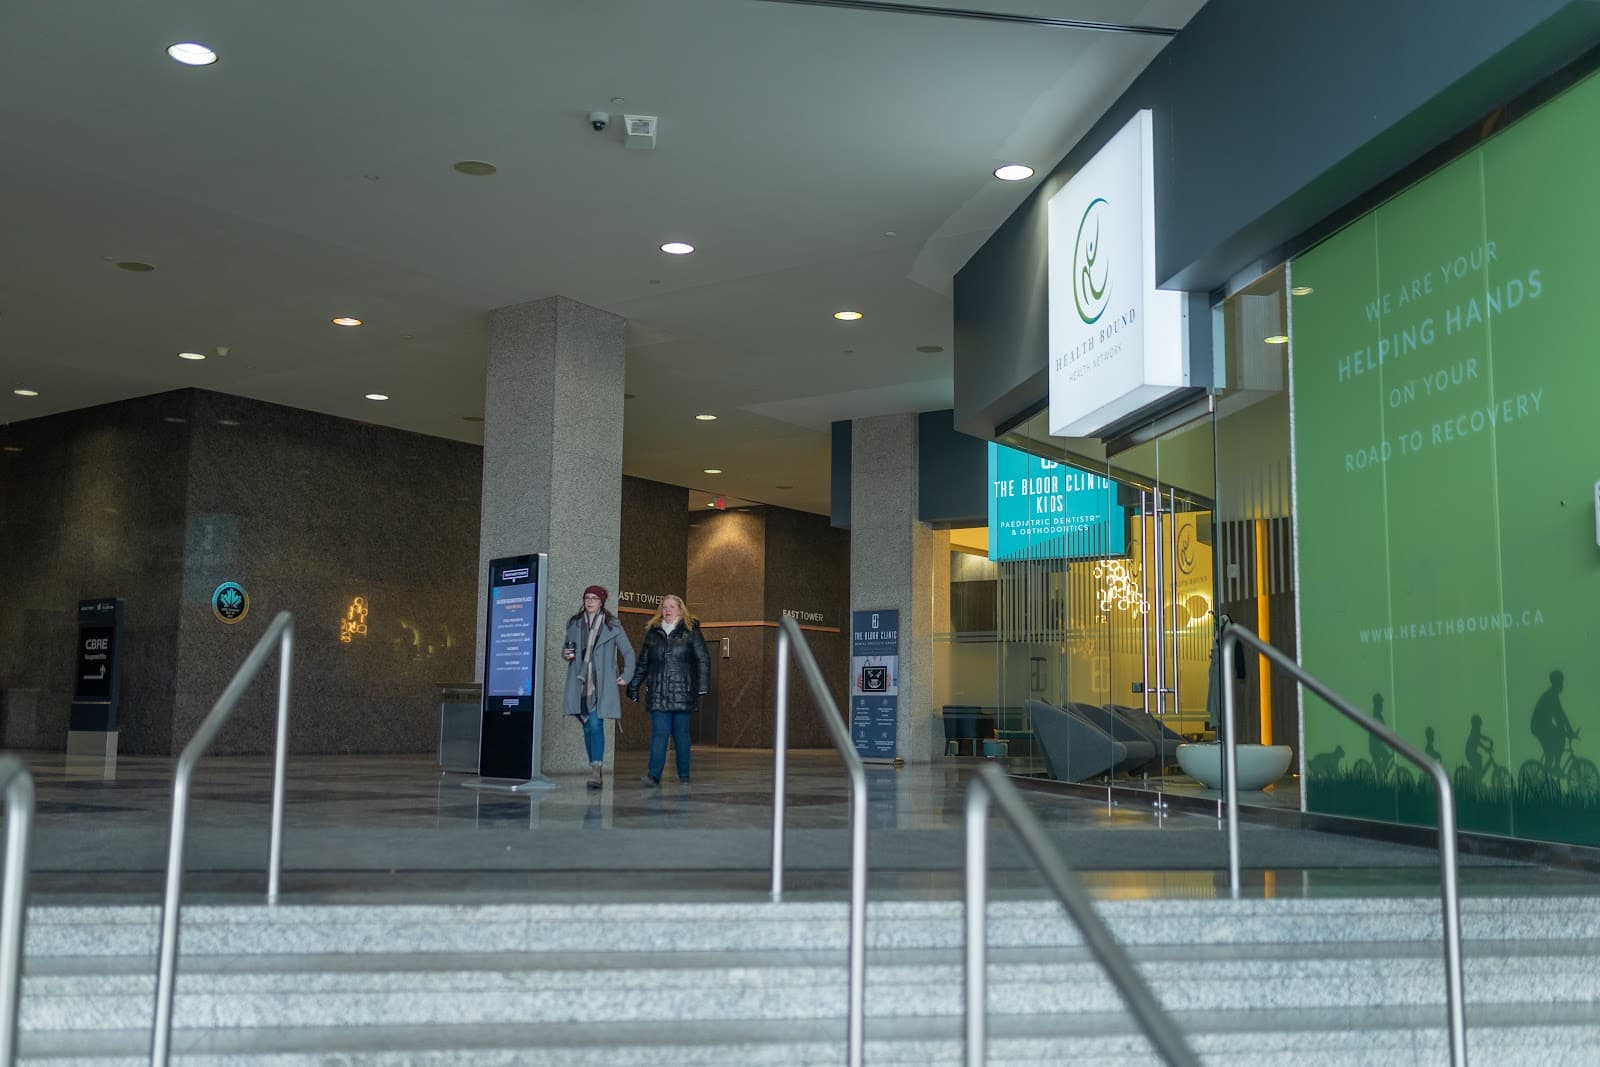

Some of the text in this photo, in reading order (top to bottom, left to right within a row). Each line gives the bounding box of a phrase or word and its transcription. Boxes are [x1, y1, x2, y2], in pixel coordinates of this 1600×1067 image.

[1365, 241, 1497, 321] WE ARE YOUR
[1338, 269, 1542, 382] HELPING HANDS
[1056, 308, 1136, 371] HEALTH BOUND
[1389, 358, 1478, 408] ON YOUR
[1345, 387, 1543, 472] ROAD TO RECOVERY
[994, 473, 1109, 498] THE BLOOR CLINIC
[1036, 495, 1063, 513] KIDS
[1000, 518, 1051, 528] PAEDIATRIC
[1020, 524, 1089, 536] ORTHODONTICS
[618, 591, 634, 601] AST
[782, 609, 824, 622] EAST TOWER
[1359, 608, 1544, 644] WWW.HEALTHBOUND.CA
[86, 638, 108, 650] CBRE
